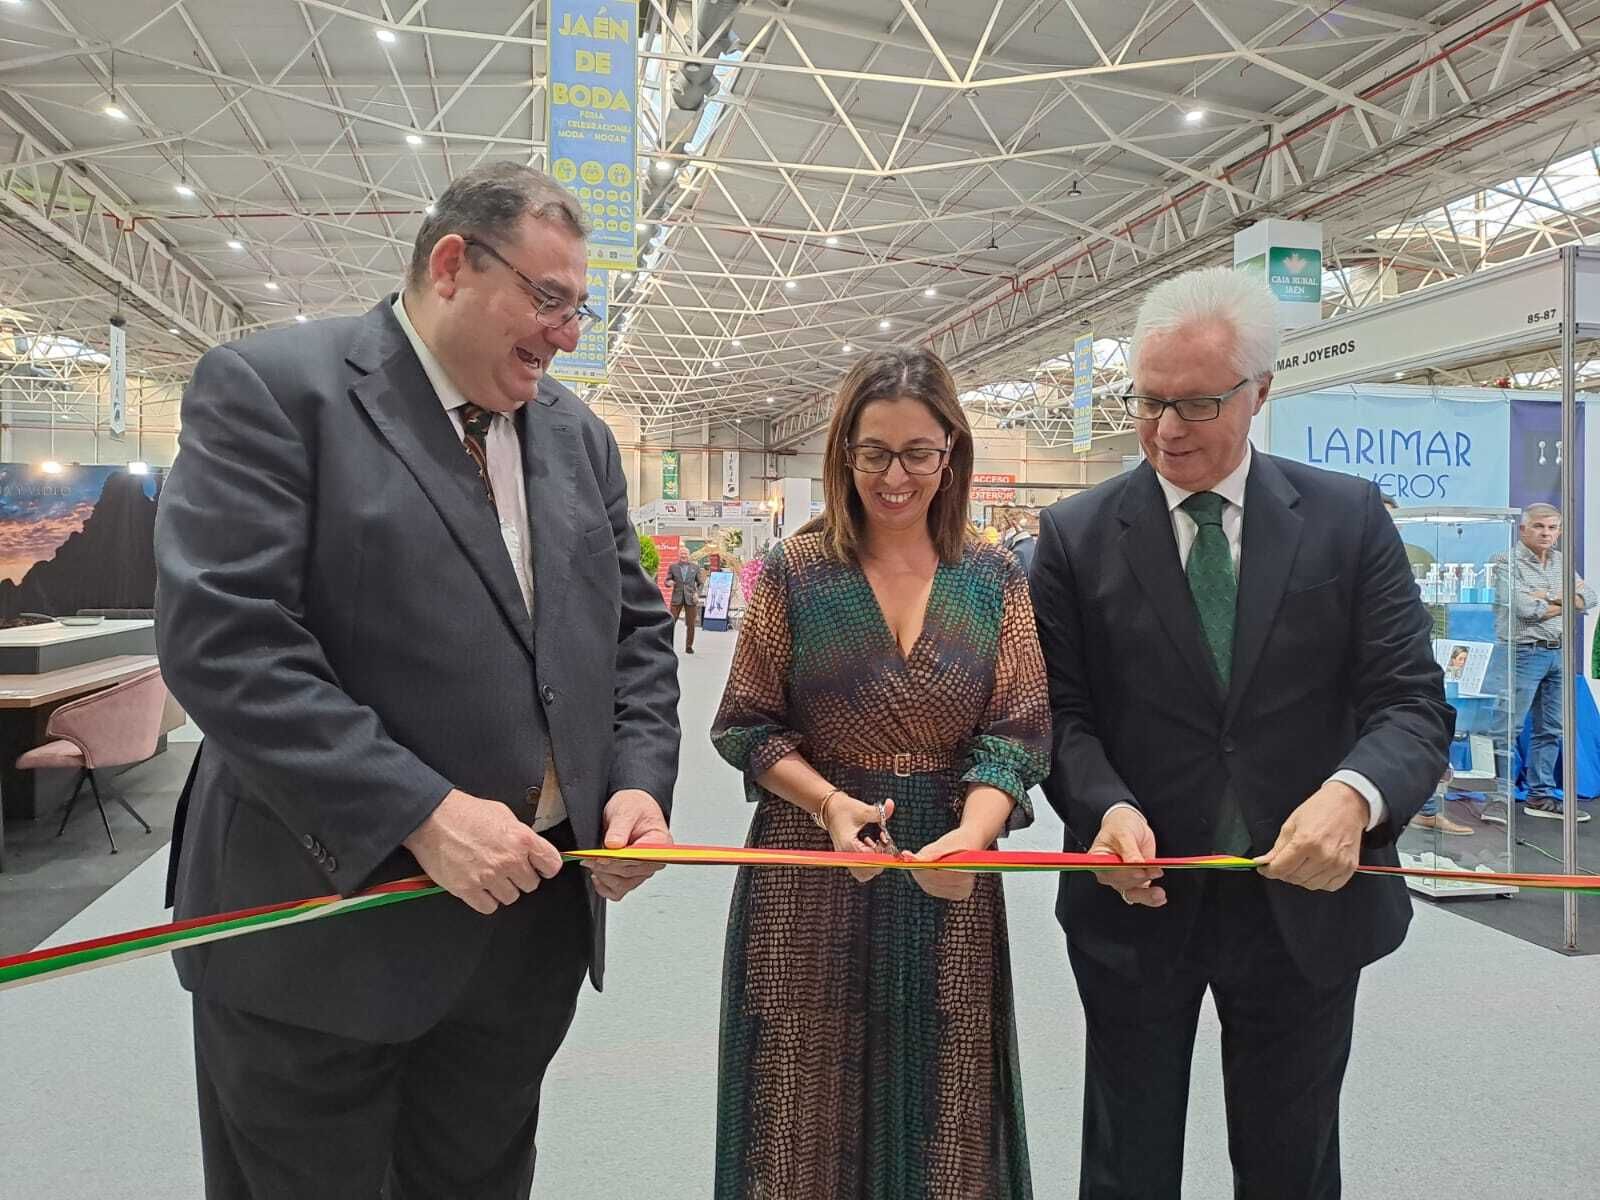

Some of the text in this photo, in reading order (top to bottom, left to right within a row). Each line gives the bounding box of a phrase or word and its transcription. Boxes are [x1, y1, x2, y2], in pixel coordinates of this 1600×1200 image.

[558, 6, 629, 43] JAÉN
[575, 50, 611, 74] DE
[552, 82, 631, 112] BODA
[558, 129, 626, 144] MODA HOGAR
[1292, 277, 1317, 286] RURAL
[1528, 308, 1556, 324] 85-87
[1302, 340, 1356, 364] JOYEROS
[1306, 426, 1472, 467] LARIMAR
[973, 475, 1009, 483] ACCESO
[1372, 472, 1449, 498] EROS
